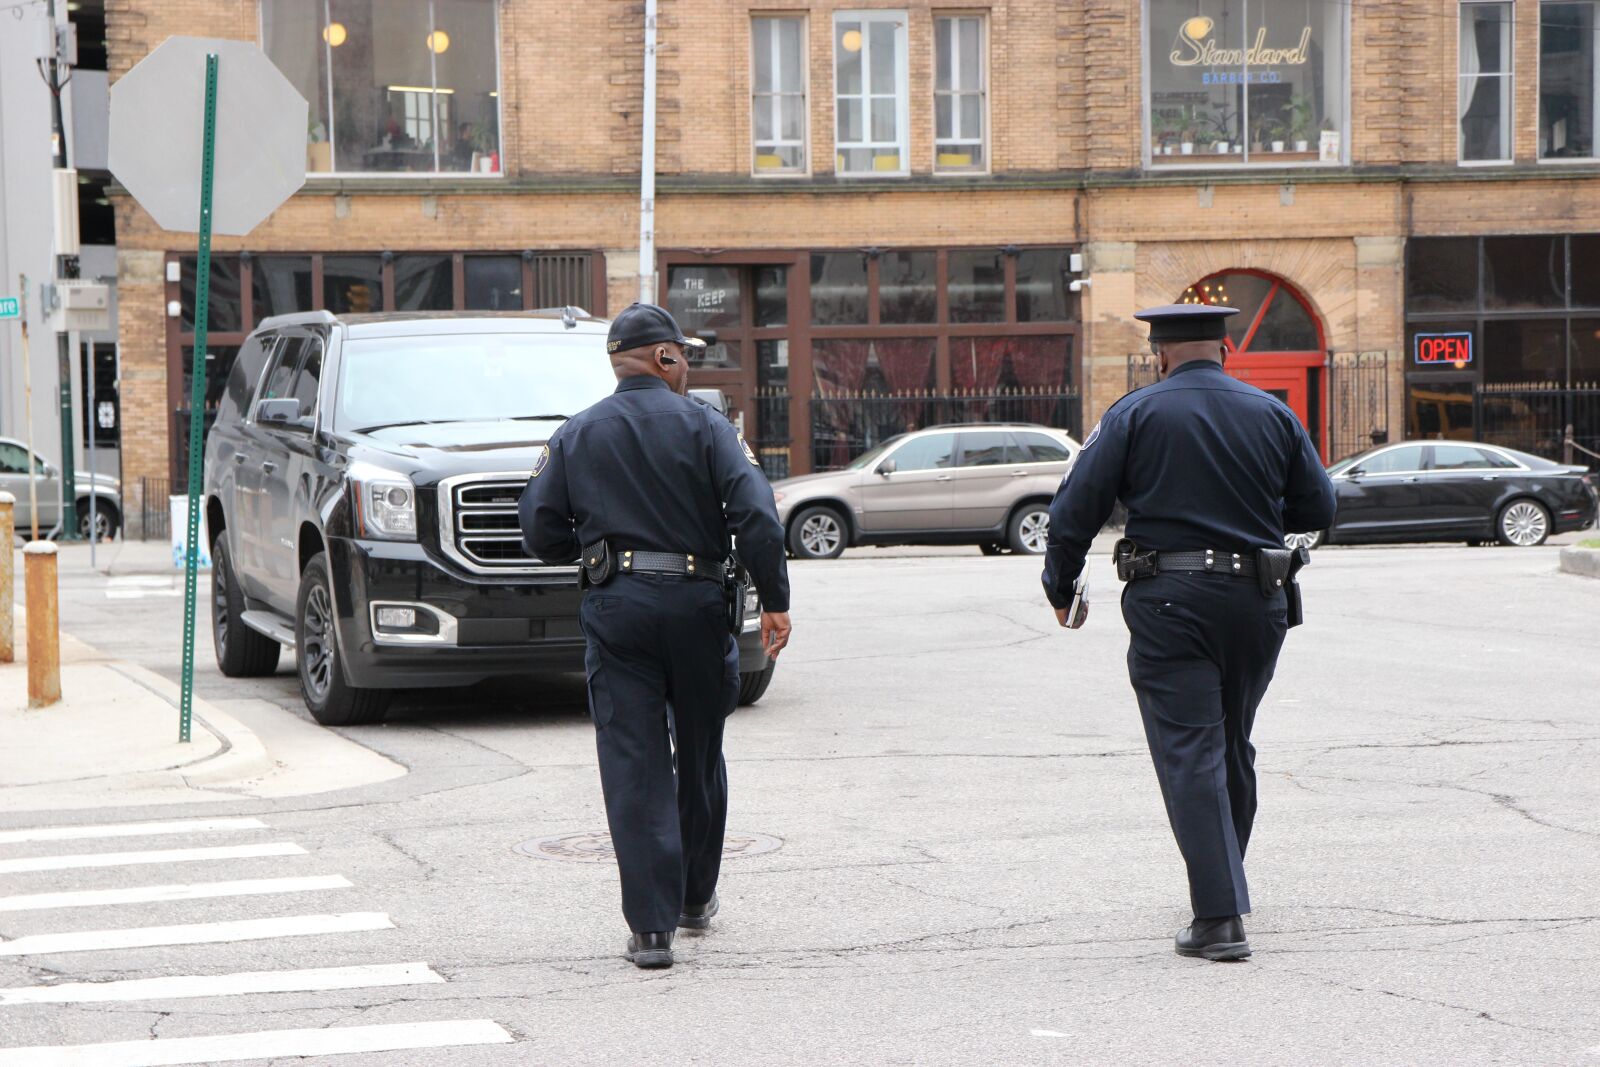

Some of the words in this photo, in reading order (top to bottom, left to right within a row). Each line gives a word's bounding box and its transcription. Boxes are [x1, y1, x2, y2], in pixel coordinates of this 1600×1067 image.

[1169, 17, 1311, 66] Standard
[684, 278, 704, 290] THE
[697, 290, 726, 307] KEEP
[1420, 338, 1469, 361] OPEN
